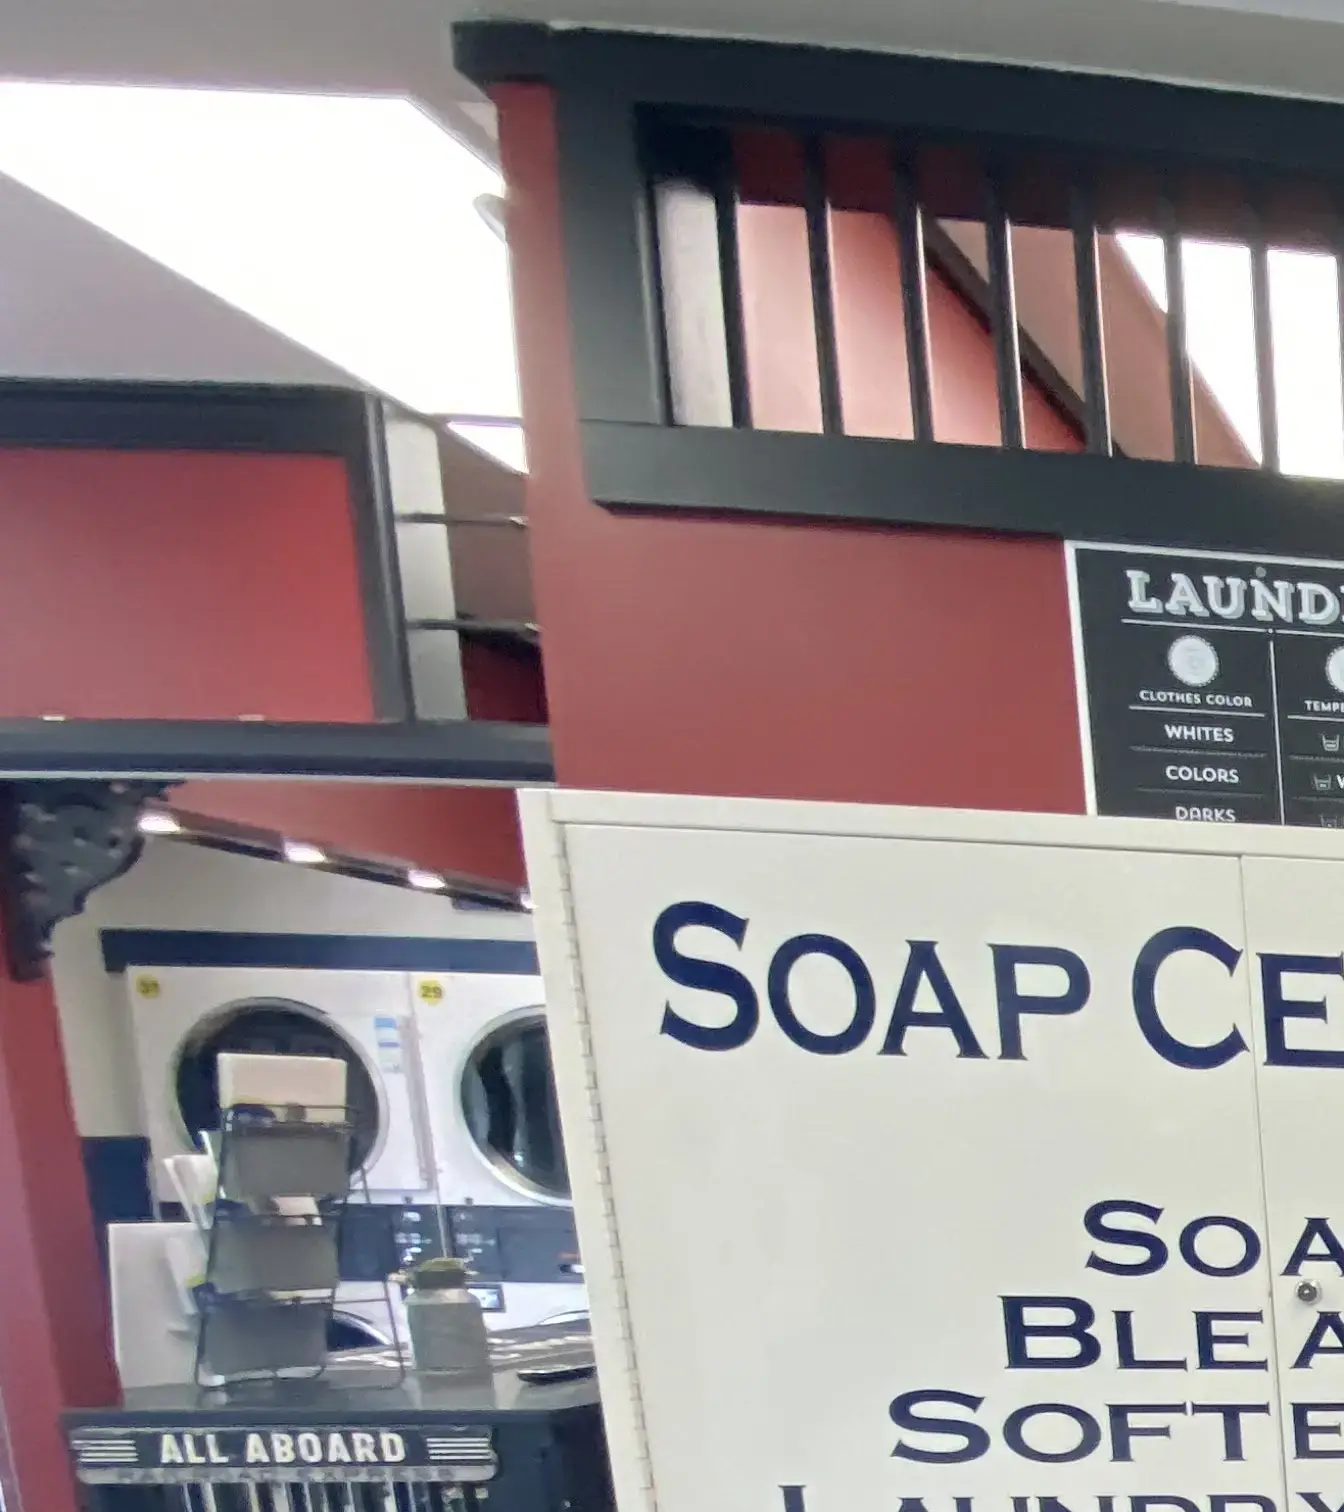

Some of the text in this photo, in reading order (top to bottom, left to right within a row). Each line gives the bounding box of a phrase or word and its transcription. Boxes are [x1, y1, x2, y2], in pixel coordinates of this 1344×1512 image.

[1139, 689, 1252, 708] CLOTHES COLOR
[1164, 724, 1235, 744] WHITES
[1165, 765, 1240, 784] COLORS
[1175, 806, 1236, 823] DARKS
[651, 898, 1093, 1063] SOAP
[160, 1431, 407, 1464] ALL ABOARD
